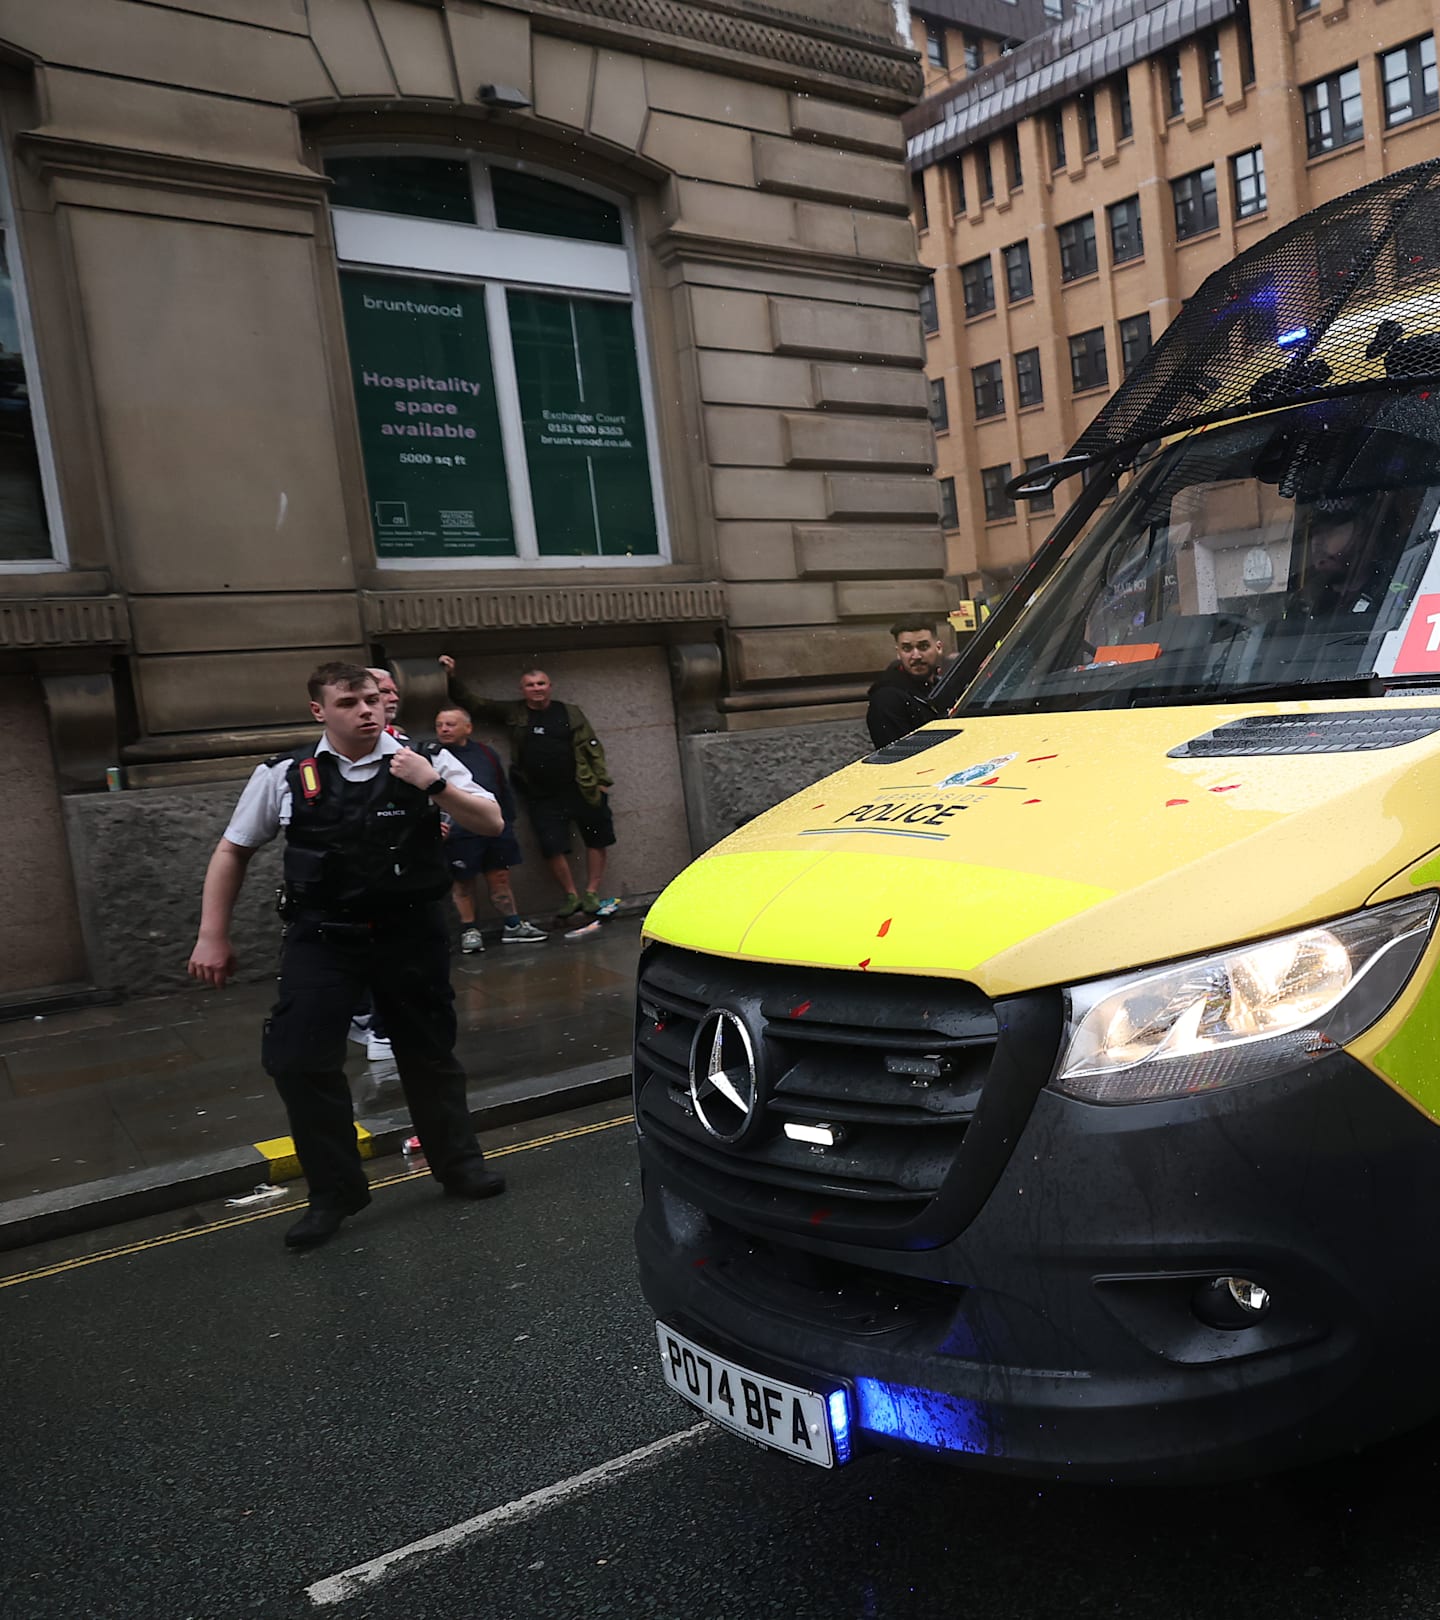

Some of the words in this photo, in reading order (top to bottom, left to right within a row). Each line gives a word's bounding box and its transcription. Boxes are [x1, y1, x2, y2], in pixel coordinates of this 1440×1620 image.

[362, 294, 463, 318] bruntwood
[362, 371, 481, 396] Hospitality
[394, 400, 458, 416] space
[542, 409, 593, 423] Exchange
[595, 413, 626, 424] Court
[381, 421, 477, 439] available
[540, 434, 632, 448] bruntwood.co.uk
[400, 453, 432, 464] 5000
[434, 455, 452, 467] sq
[454, 455, 467, 466] ft
[873, 793, 990, 803] MERSEYSIDE
[377, 809, 406, 817] POLICE
[833, 803, 969, 826] POLICE
[667, 1337, 735, 1417] PO74
[740, 1377, 812, 1450] BFA
